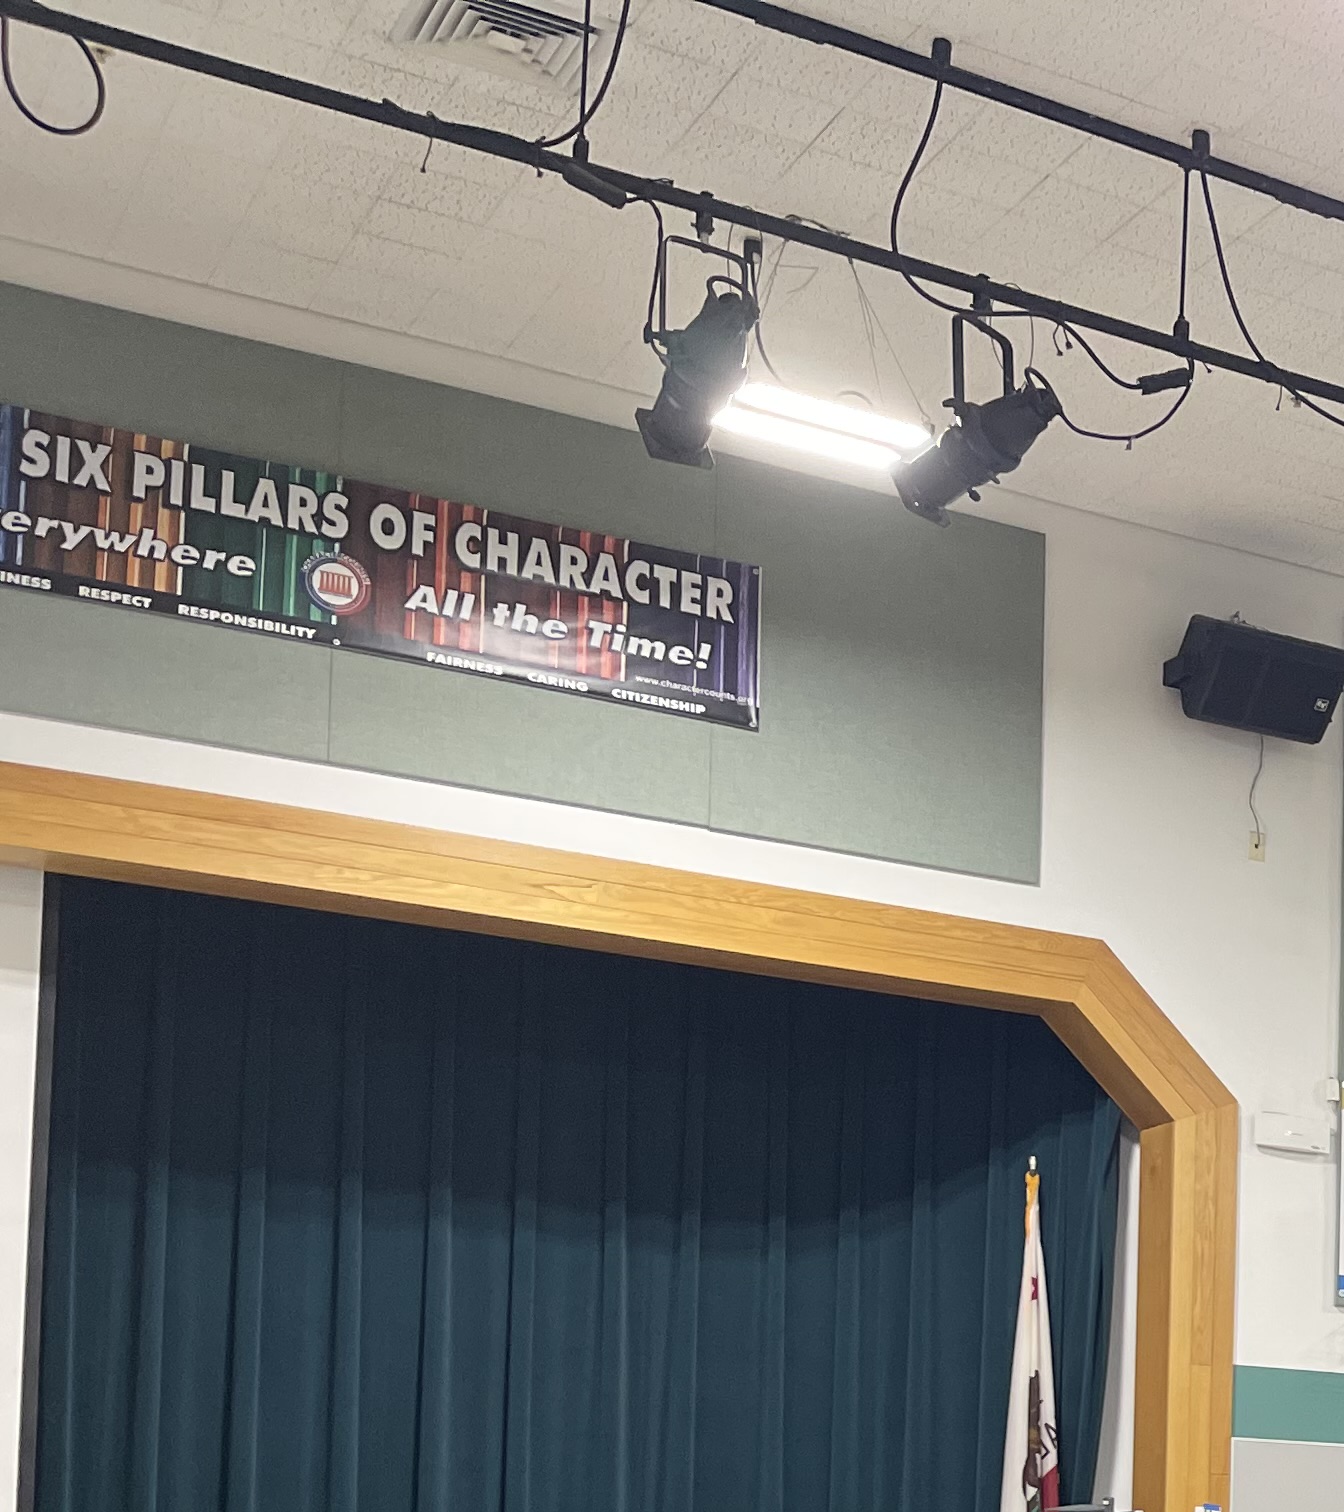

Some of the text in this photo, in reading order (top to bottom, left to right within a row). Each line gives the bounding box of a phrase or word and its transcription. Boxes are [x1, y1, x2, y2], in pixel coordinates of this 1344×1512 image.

[0, 508, 257, 577] erywhere
[19, 428, 112, 493] SIX
[131, 450, 349, 539] PILLARS
[368, 503, 436, 557] OF
[454, 522, 735, 624] CHARACTER
[78, 585, 153, 609] RESPECT
[177, 603, 317, 639] RESPONSIBILITY
[426, 651, 504, 676] FAIRNESS
[526, 672, 589, 693] CARING
[611, 687, 706, 714] CITIZENSHIP
[404, 584, 712, 671] All the Time!
